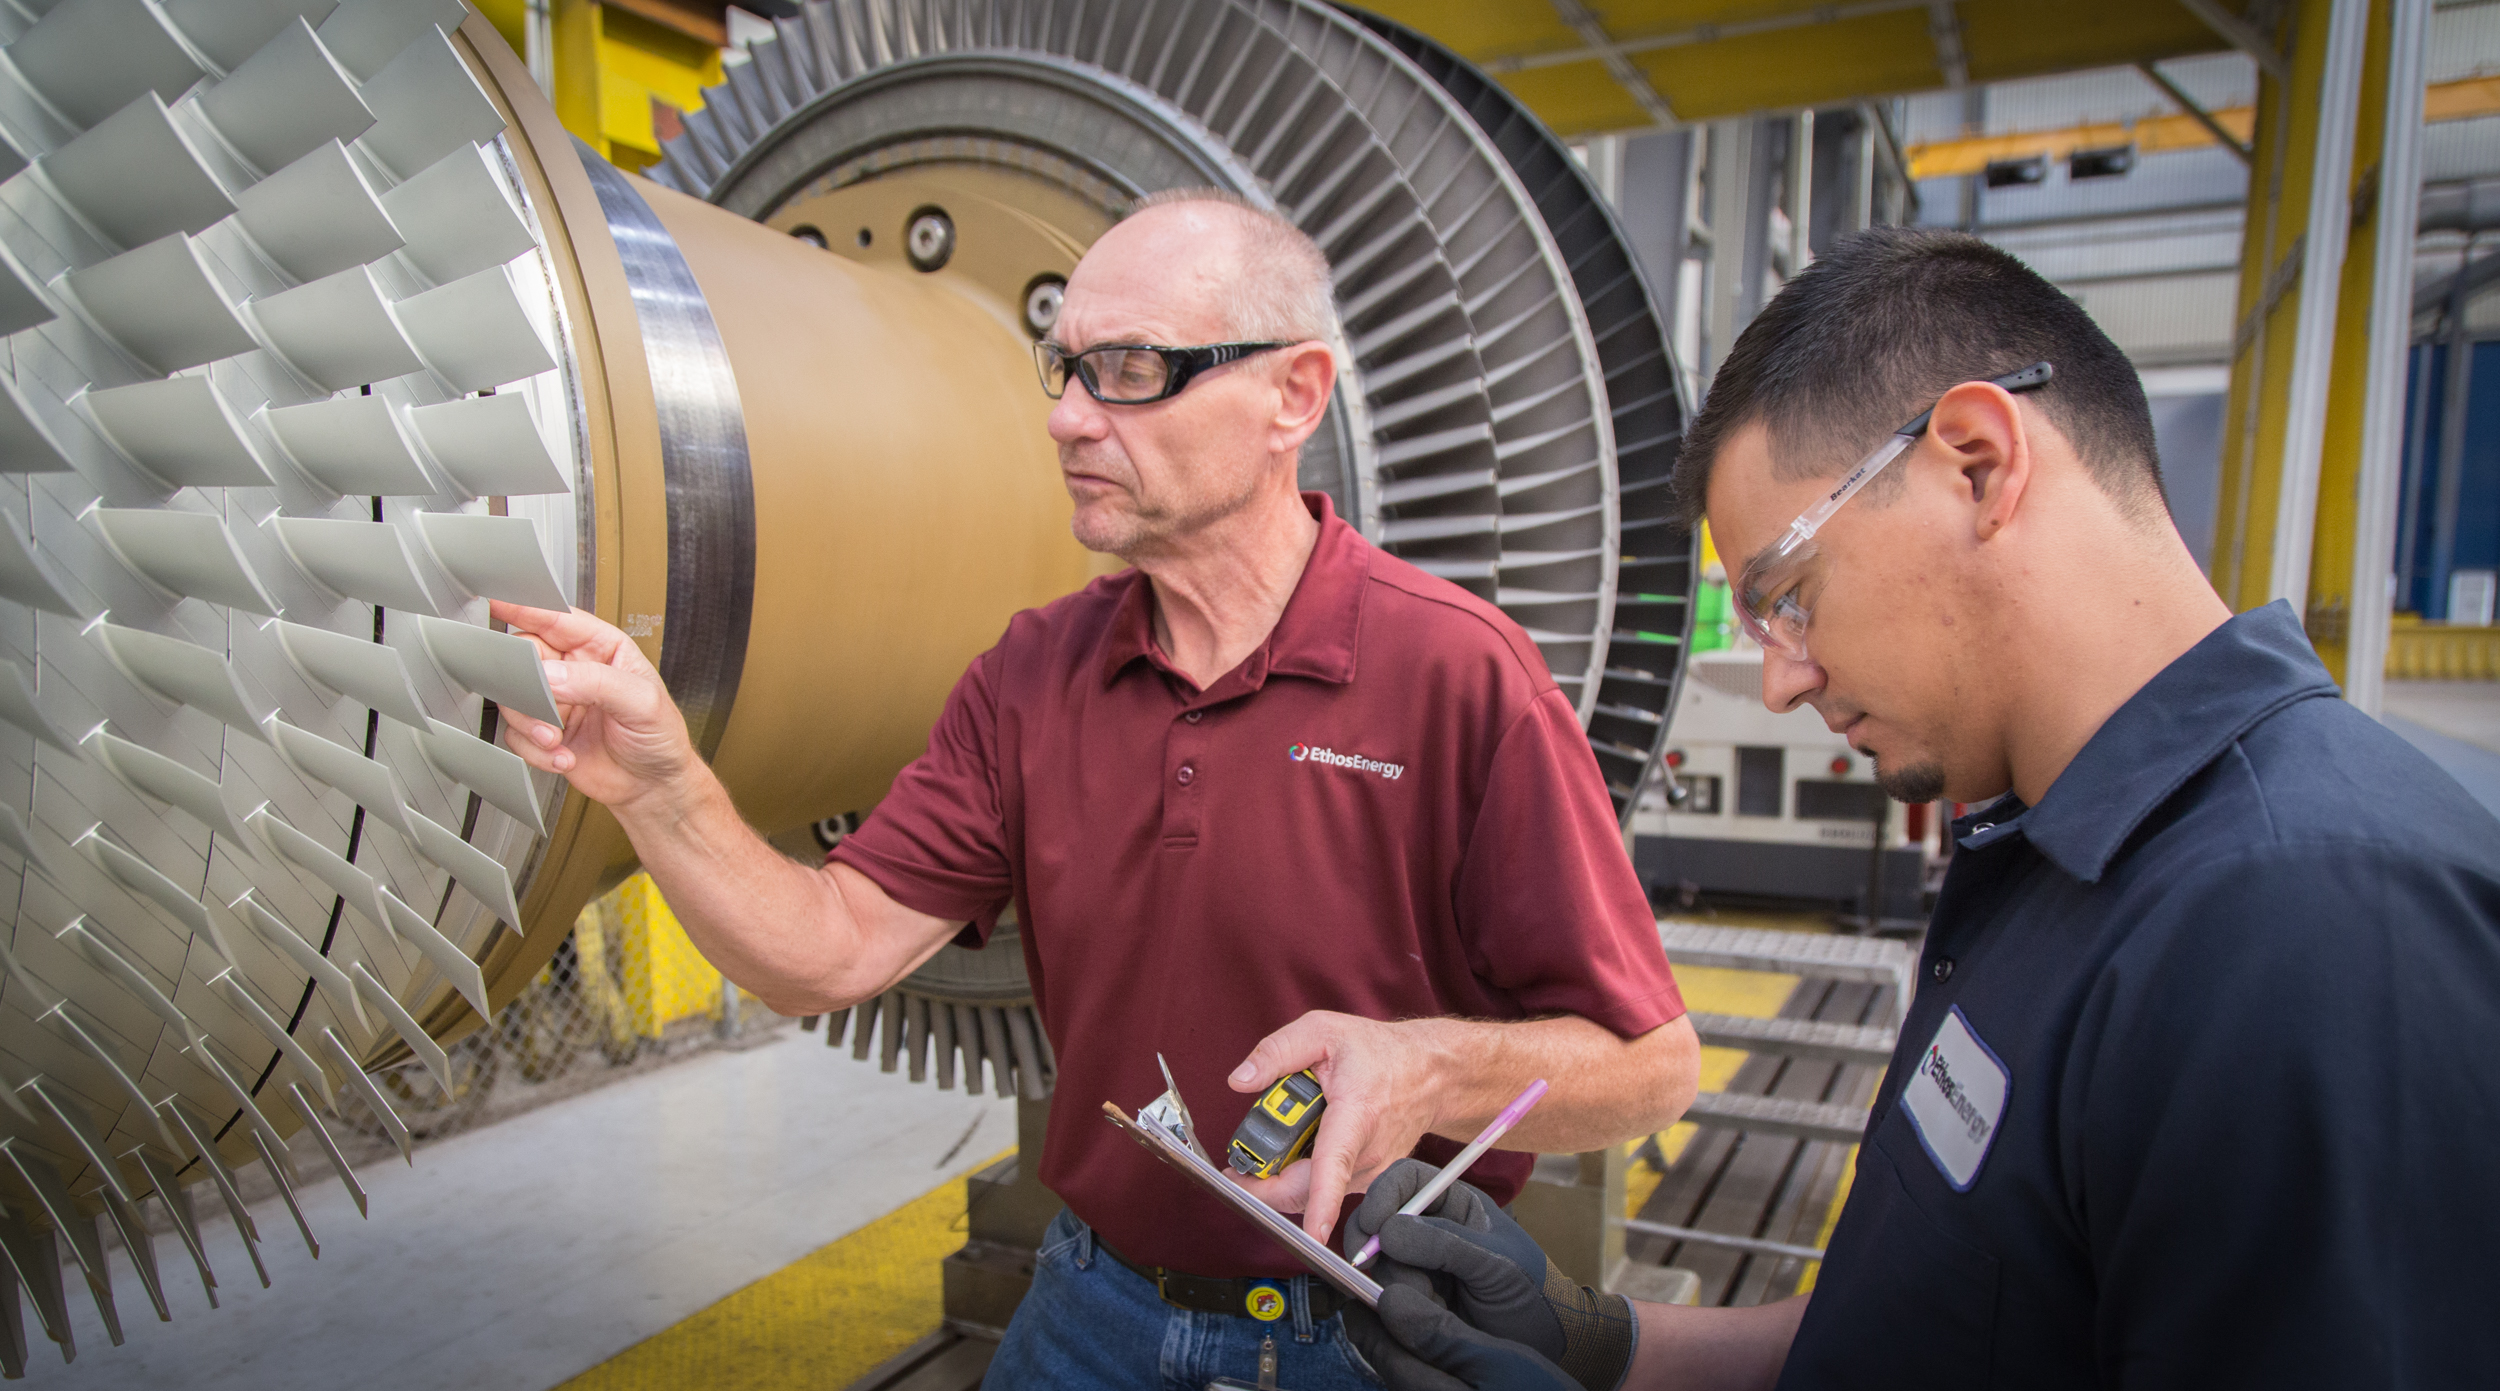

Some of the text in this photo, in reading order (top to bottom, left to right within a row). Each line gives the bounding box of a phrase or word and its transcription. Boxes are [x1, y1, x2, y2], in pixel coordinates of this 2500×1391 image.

[1830, 467, 1866, 501] Bearkat
[1309, 746, 1404, 780] EthosEnergy
[1930, 1054, 1991, 1144] EthosEnergy
